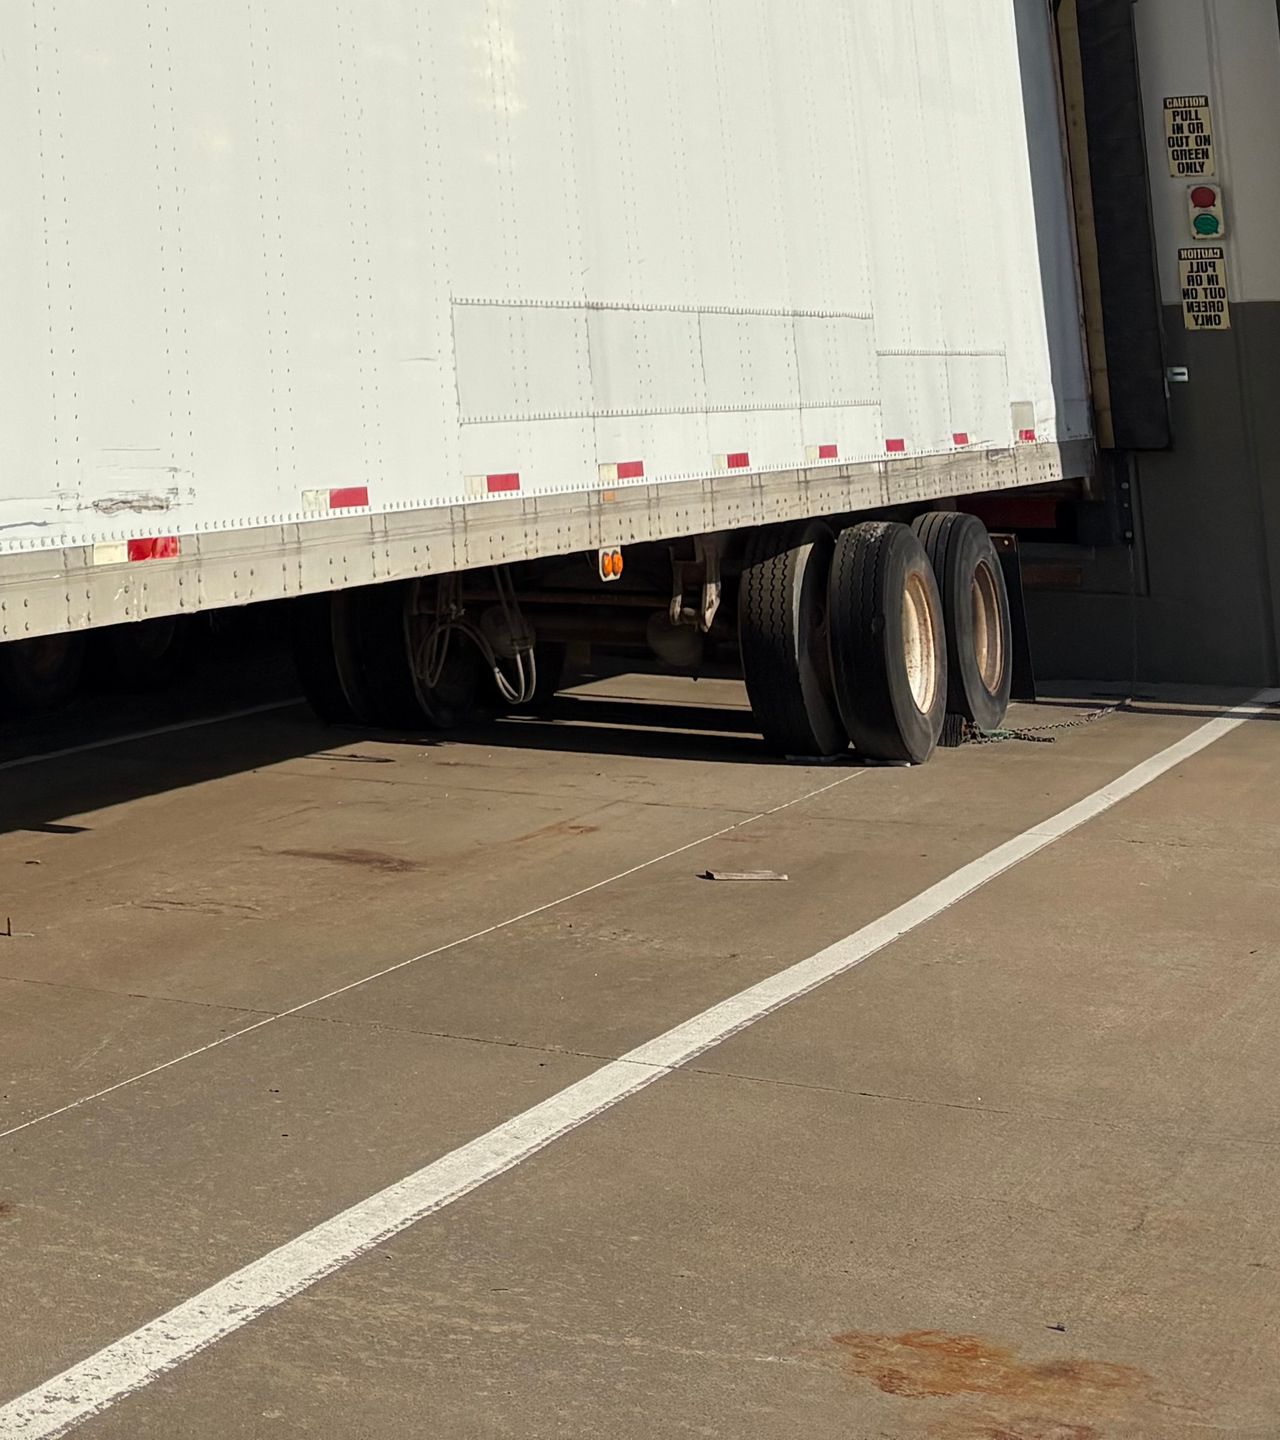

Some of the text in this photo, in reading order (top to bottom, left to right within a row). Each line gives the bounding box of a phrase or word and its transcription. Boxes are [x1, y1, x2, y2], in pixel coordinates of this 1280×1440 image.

[1166, 96, 1206, 108] CAUTION
[1172, 109, 1202, 122] PULL
[1172, 122, 1204, 135] IN OR
[1167, 134, 1211, 148] OUT ON
[1172, 148, 1209, 161] GREEN
[1177, 161, 1205, 174] ONLY
